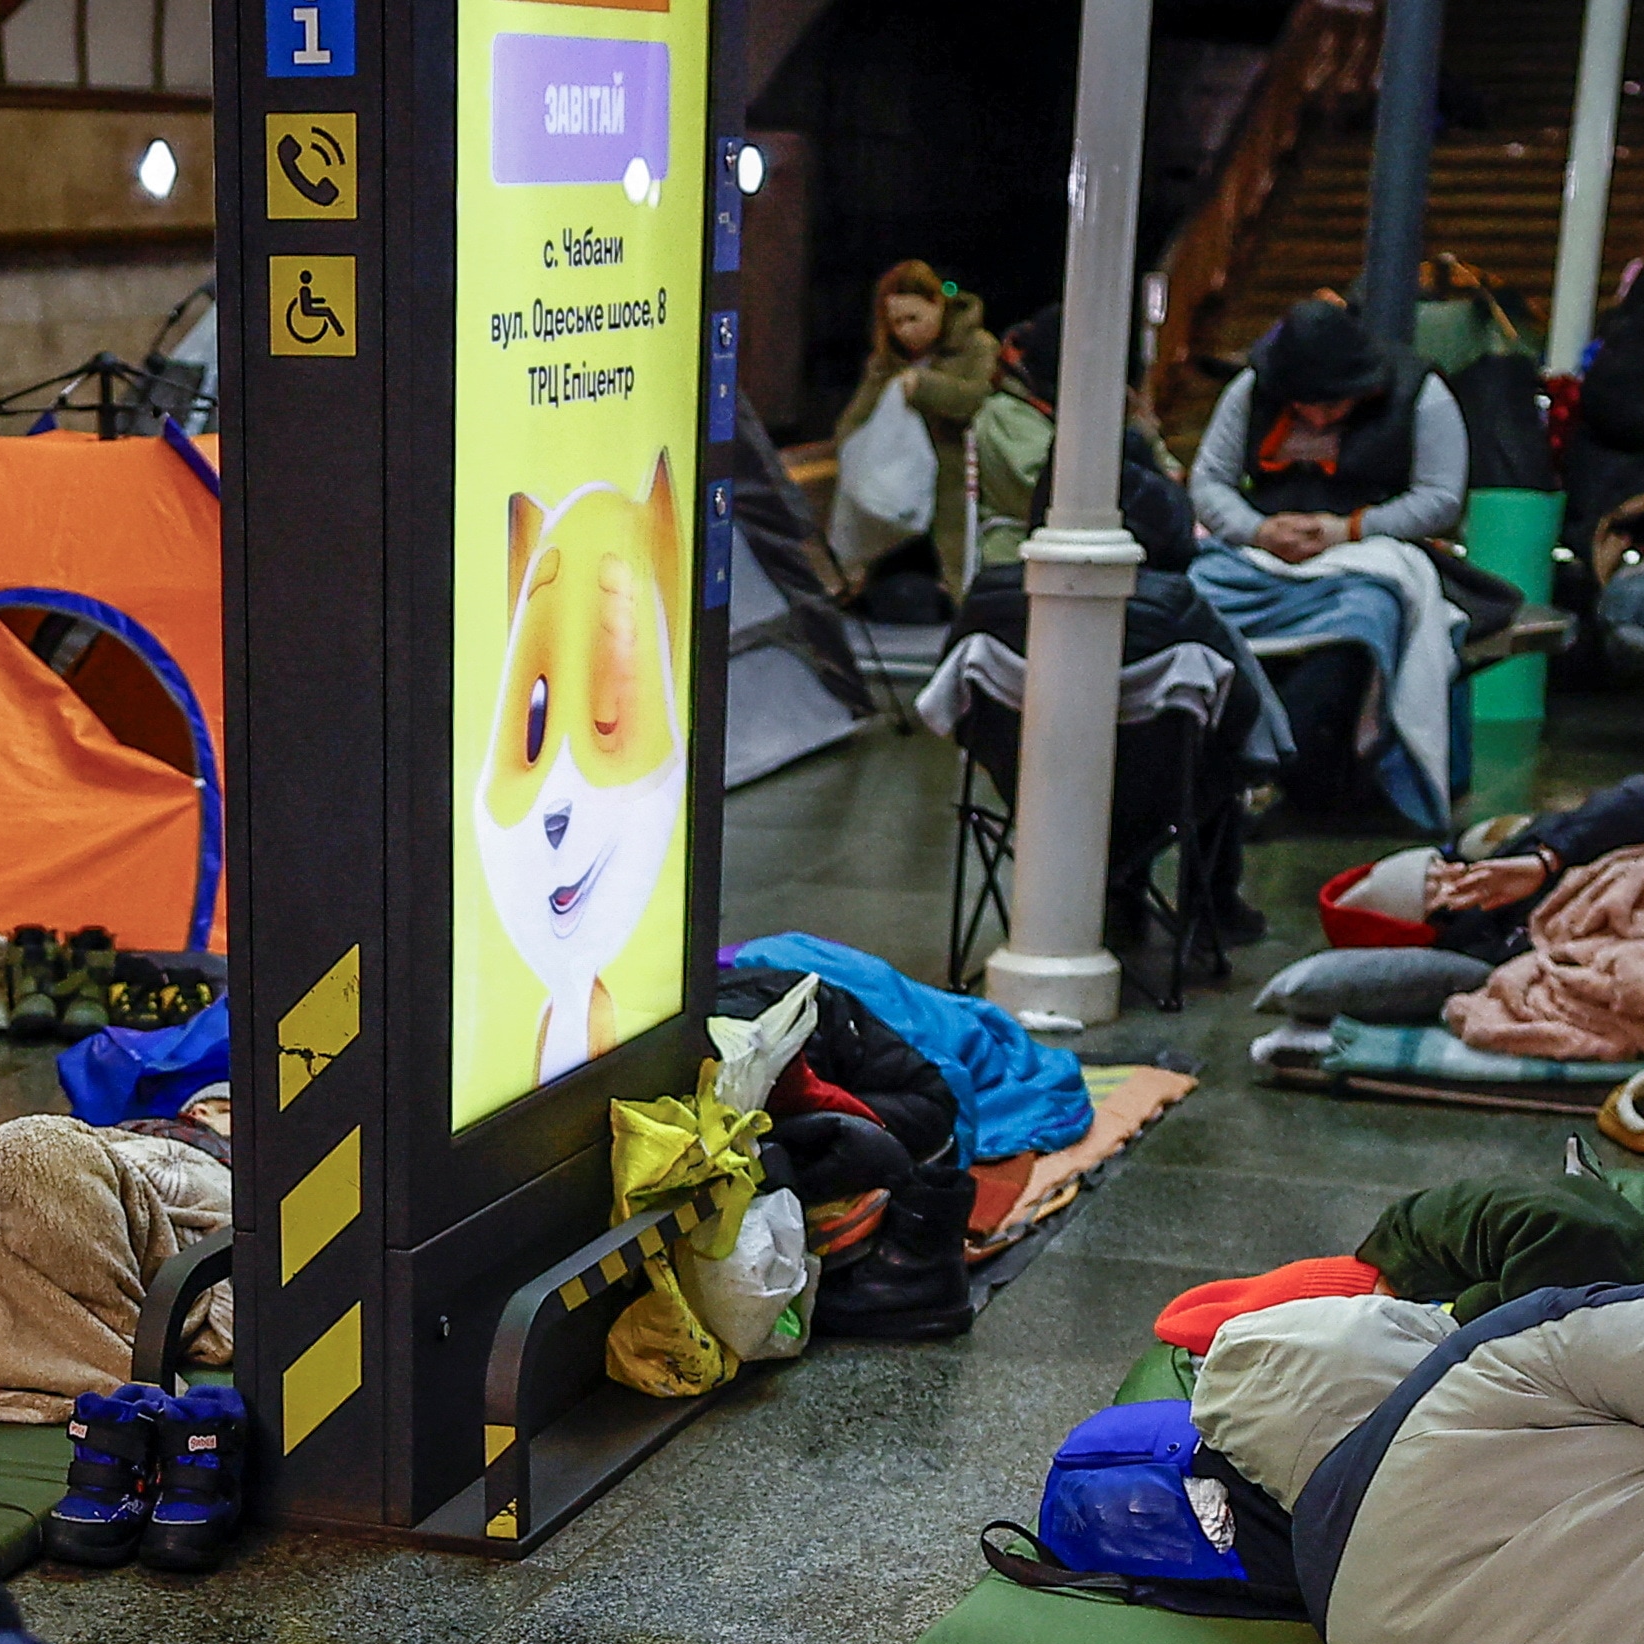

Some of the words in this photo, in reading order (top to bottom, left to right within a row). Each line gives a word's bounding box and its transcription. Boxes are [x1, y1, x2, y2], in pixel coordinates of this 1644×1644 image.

[544, 71, 626, 135] ЗАВІТАЙ
[543, 239, 559, 269] с.
[562, 226, 624, 267] Чабани
[491, 311, 528, 350] вул.
[533, 297, 604, 342] Одеське
[608, 299, 654, 329] шосе,
[657, 286, 667, 325] 8
[527, 364, 559, 408] ТРЦ
[563, 360, 635, 403] Епіцентр
